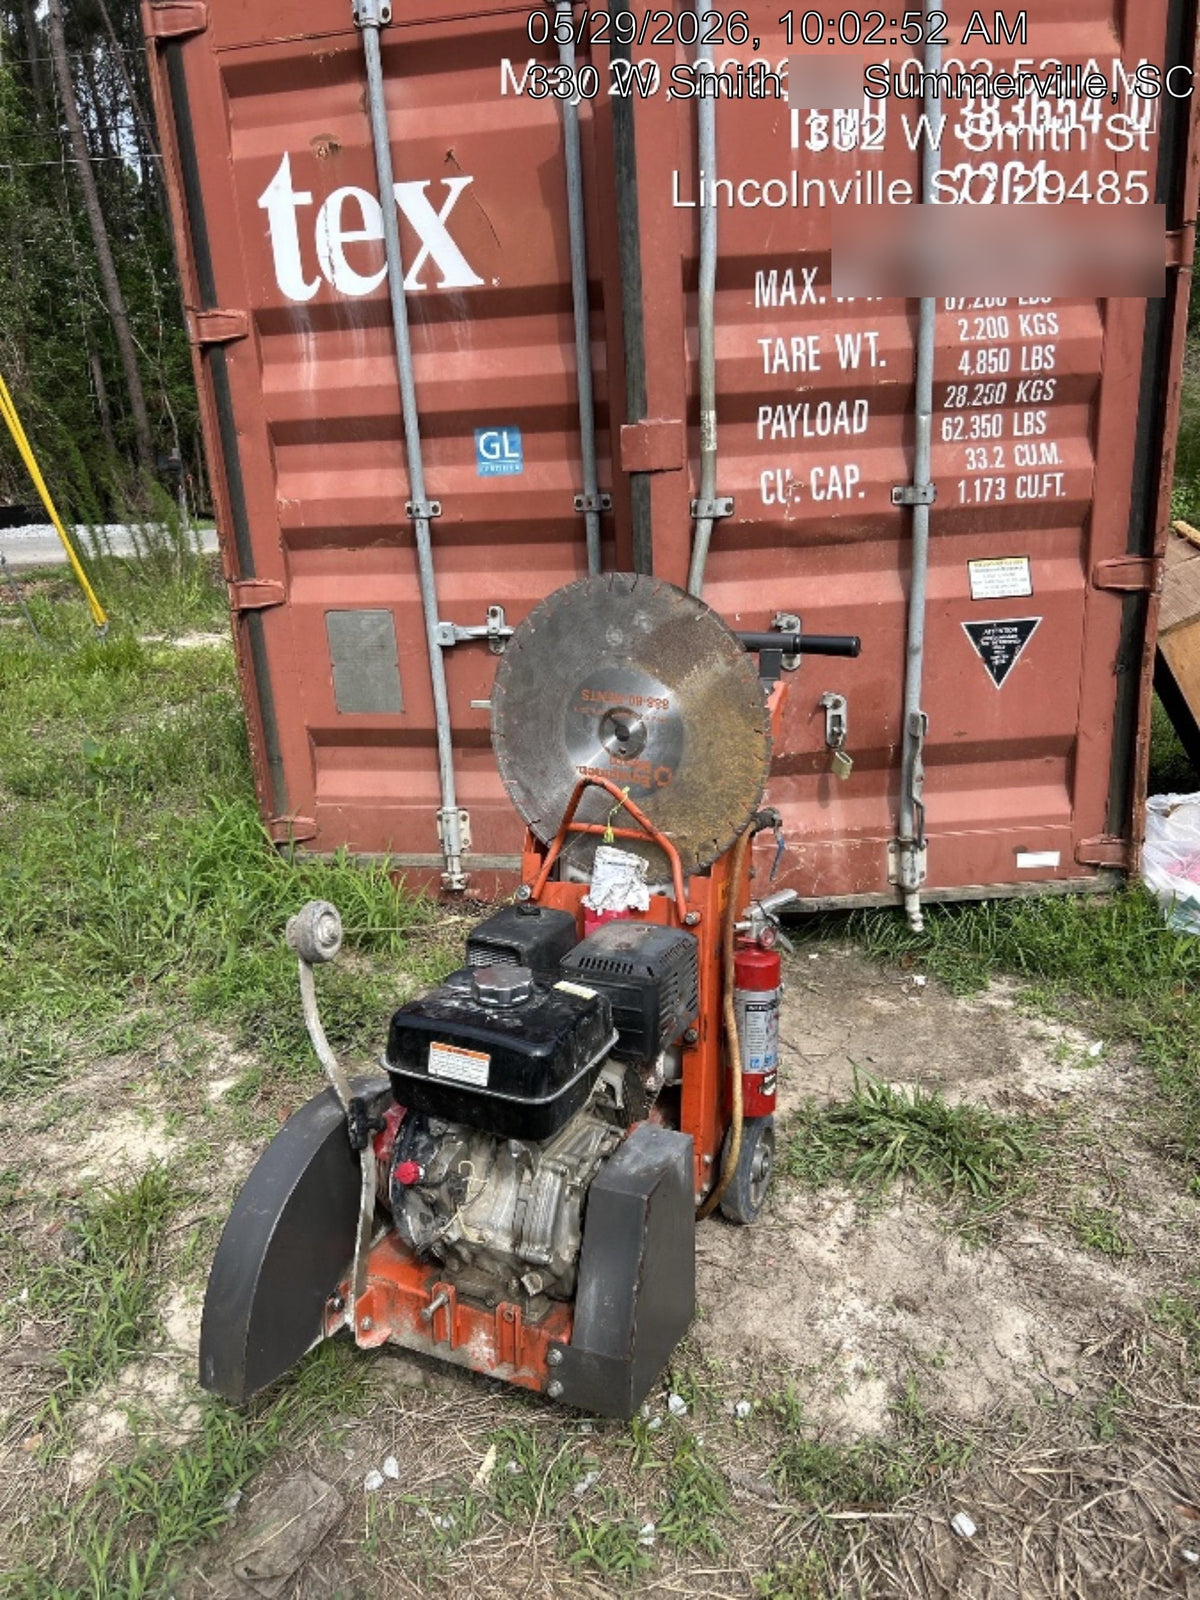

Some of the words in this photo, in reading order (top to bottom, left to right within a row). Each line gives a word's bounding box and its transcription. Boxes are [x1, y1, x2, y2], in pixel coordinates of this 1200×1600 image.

[257, 151, 484, 301] tex
[755, 266, 826, 309] MAX.
[958, 315, 1010, 341] 2.200
[1018, 312, 1060, 337] KGS
[757, 335, 821, 375] TARE
[834, 331, 887, 369] WT.
[1020, 344, 1056, 372] LBS
[1014, 378, 1057, 403] KGS
[757, 400, 869, 441] PAYLOAD
[1012, 410, 1048, 436] LBS
[480, 431, 520, 459] GL
[964, 445, 1006, 471] 33.2
[810, 463, 866, 501] CAP.
